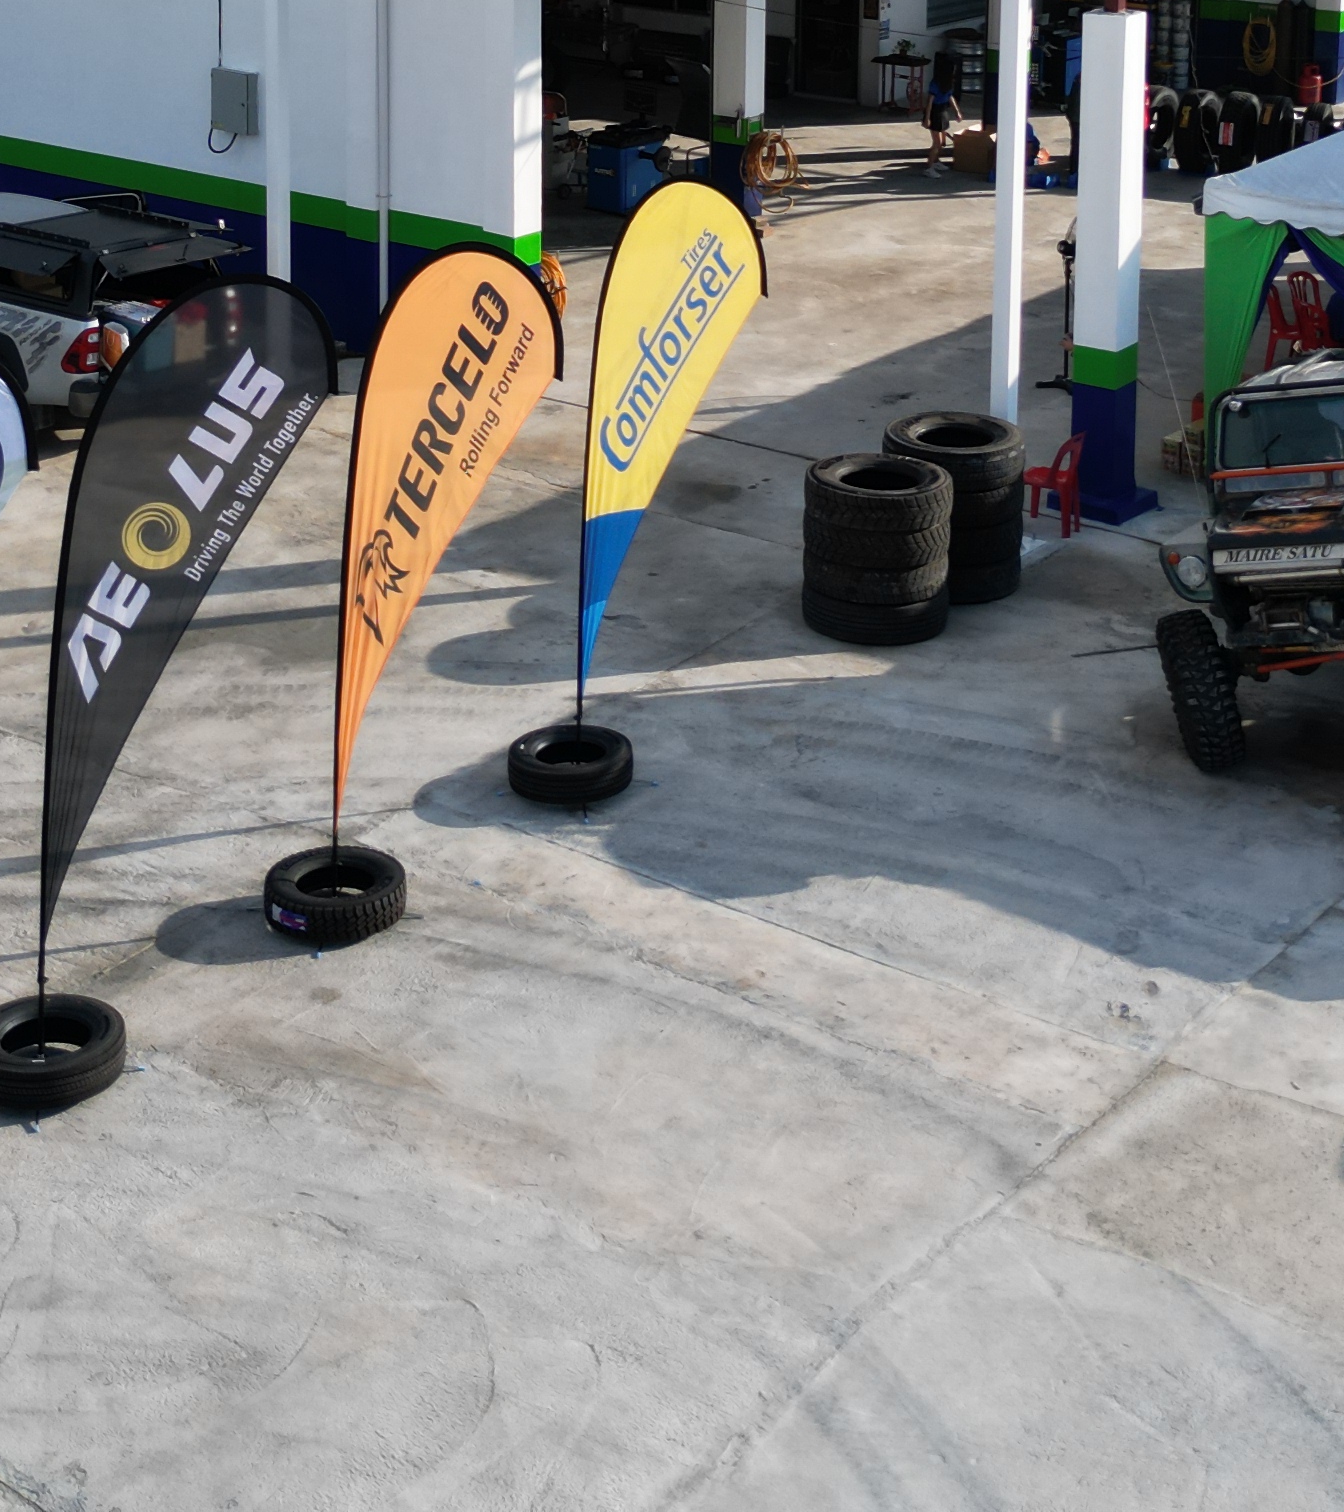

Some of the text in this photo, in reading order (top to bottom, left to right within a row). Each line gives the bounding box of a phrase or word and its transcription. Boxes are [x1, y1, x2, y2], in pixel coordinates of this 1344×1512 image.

[681, 228, 715, 268] Tires
[384, 281, 510, 540] TERCELO
[459, 322, 535, 479] Rolling Forward
[600, 239, 733, 473] Comforser
[67, 346, 286, 703] AEOLUS
[183, 392, 319, 582] Driving The World Together.
[1224, 544, 1335, 563] MAIRE SATU
